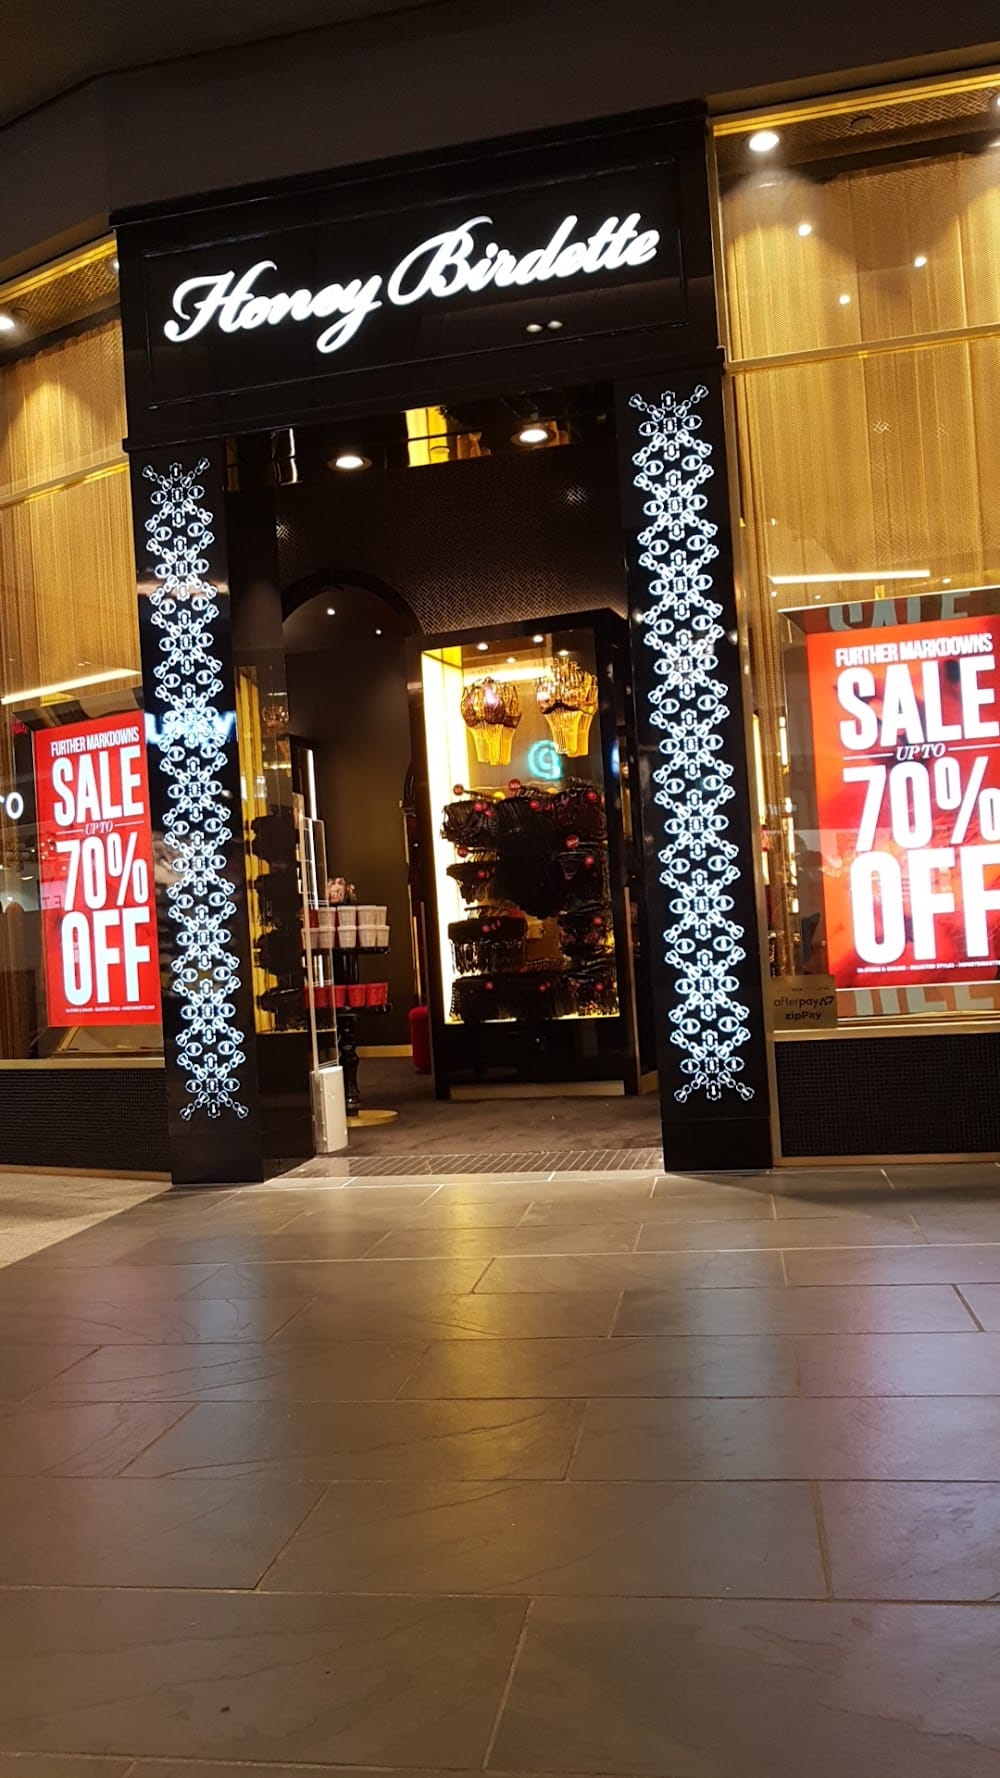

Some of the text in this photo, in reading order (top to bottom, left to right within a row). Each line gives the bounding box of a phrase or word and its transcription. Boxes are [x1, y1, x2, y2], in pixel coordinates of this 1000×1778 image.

[163, 212, 661, 354] Honey Birdette
[835, 632, 994, 668] FURTHER MARKDOWNS
[50, 736, 86, 757] FURTHER
[86, 726, 140, 751] MARKDOWNS
[836, 655, 1000, 750] SALE
[52, 745, 145, 827] SALE
[896, 742, 946, 760] UP TO
[85, 820, 113, 835] UP TO
[842, 756, 1000, 852] 70%
[55, 831, 149, 911] 70%
[61, 907, 151, 1006] OFF
